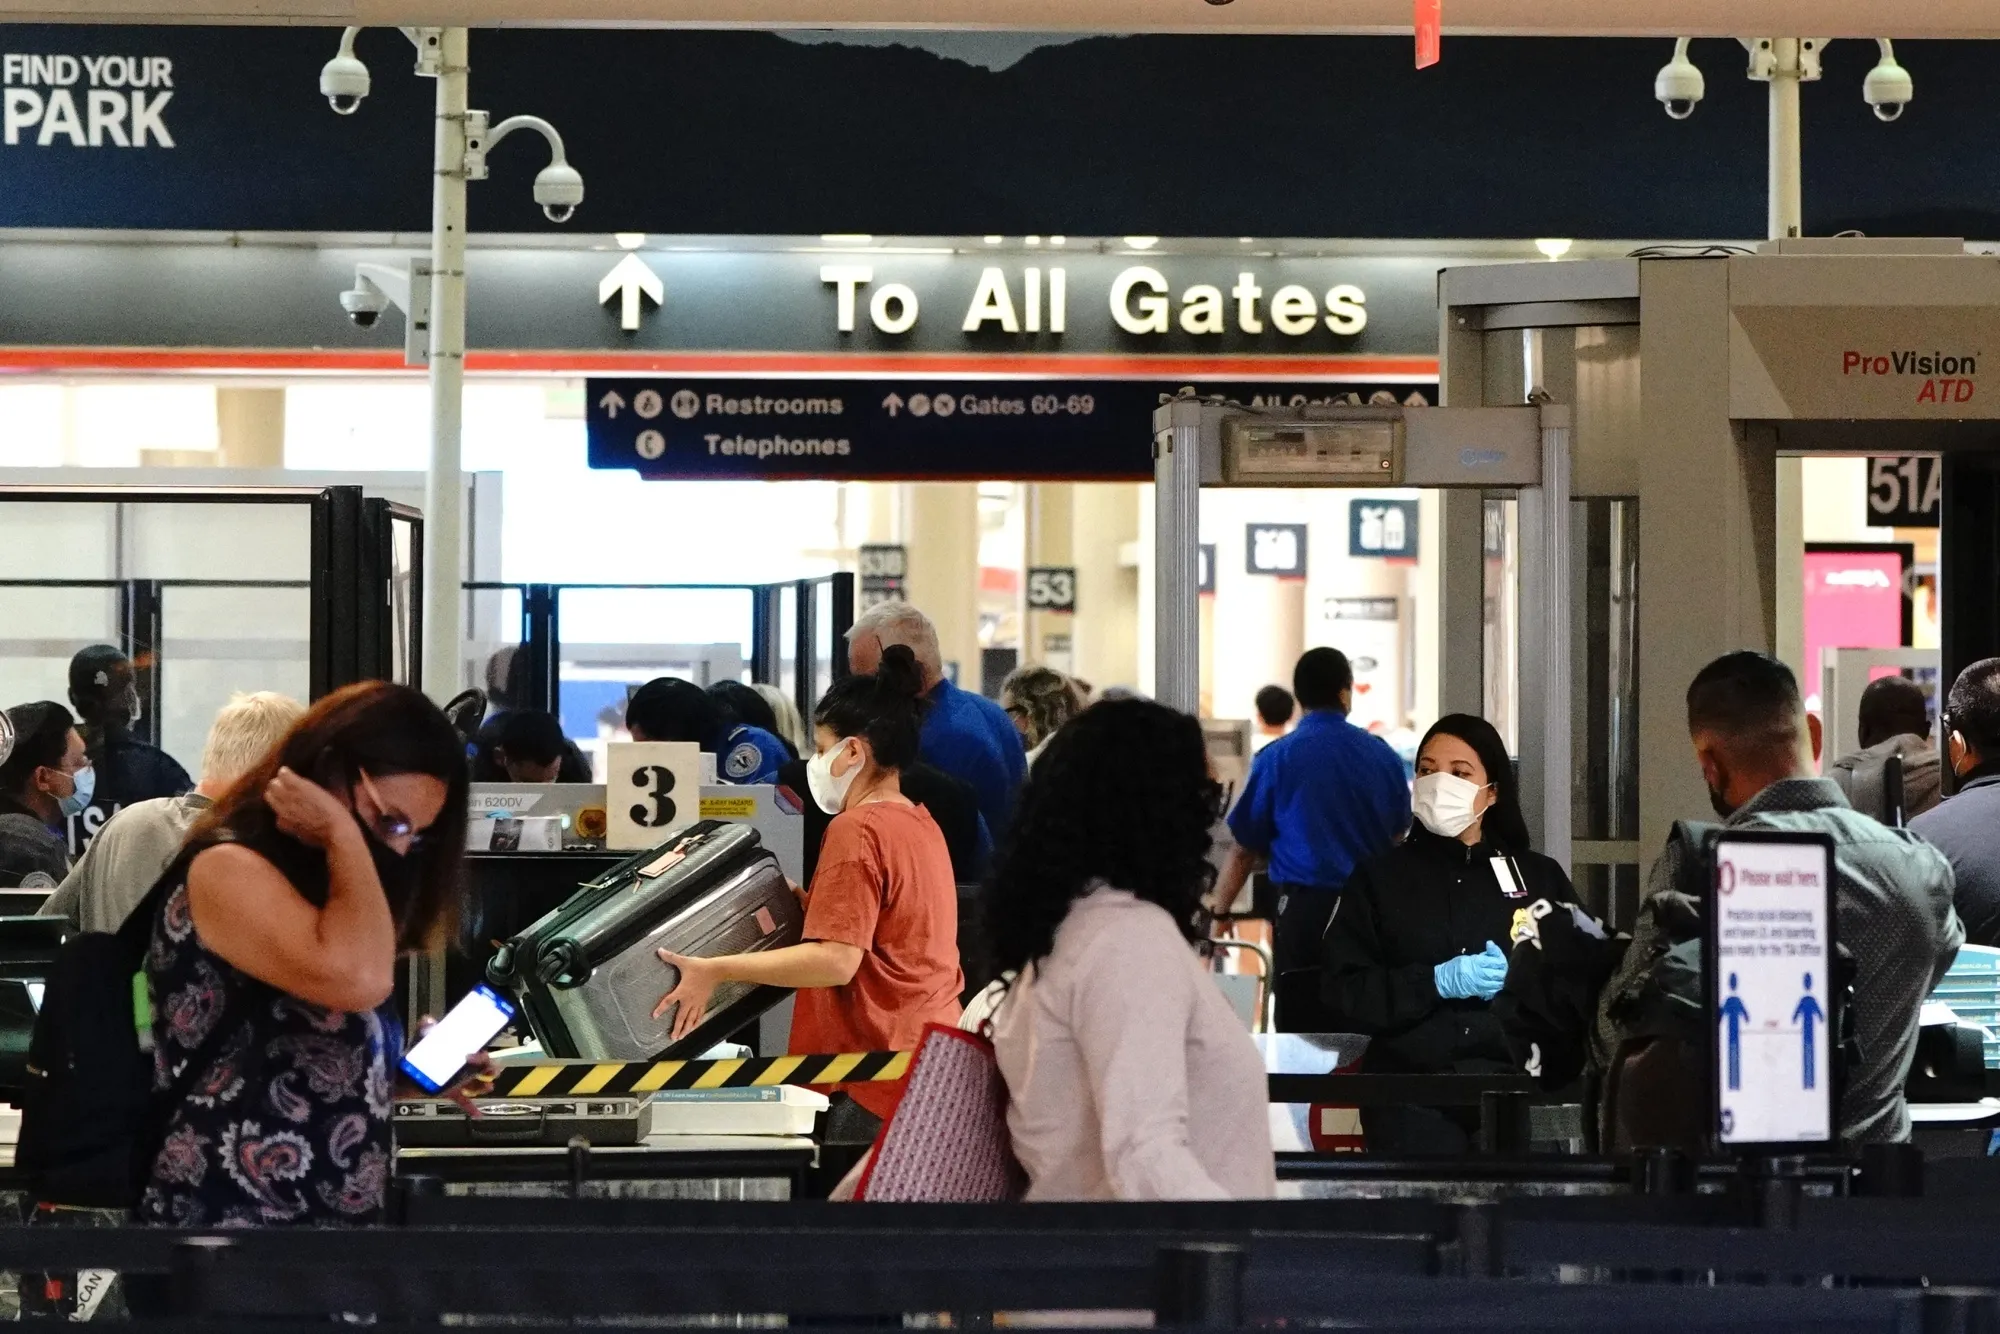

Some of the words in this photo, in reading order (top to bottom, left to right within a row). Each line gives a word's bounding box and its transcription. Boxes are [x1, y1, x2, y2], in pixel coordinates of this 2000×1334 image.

[3, 53, 80, 86] FIND
[81, 55, 173, 88] YOUR
[3, 88, 175, 148] PARK
[819, 264, 919, 335] To
[962, 265, 1066, 335] All
[1109, 265, 1368, 336] Gates
[1843, 350, 1976, 375] ProVision
[705, 393, 844, 415] Restrooms
[959, 394, 1026, 415] Gates
[1031, 394, 1095, 415] 60-69
[1916, 377, 1974, 404] ATD
[704, 433, 850, 460] Telephones
[1029, 571, 1073, 606] 53
[484, 796, 523, 808] 620DV
[629, 765, 677, 828] 3
[68, 803, 121, 855] TS
